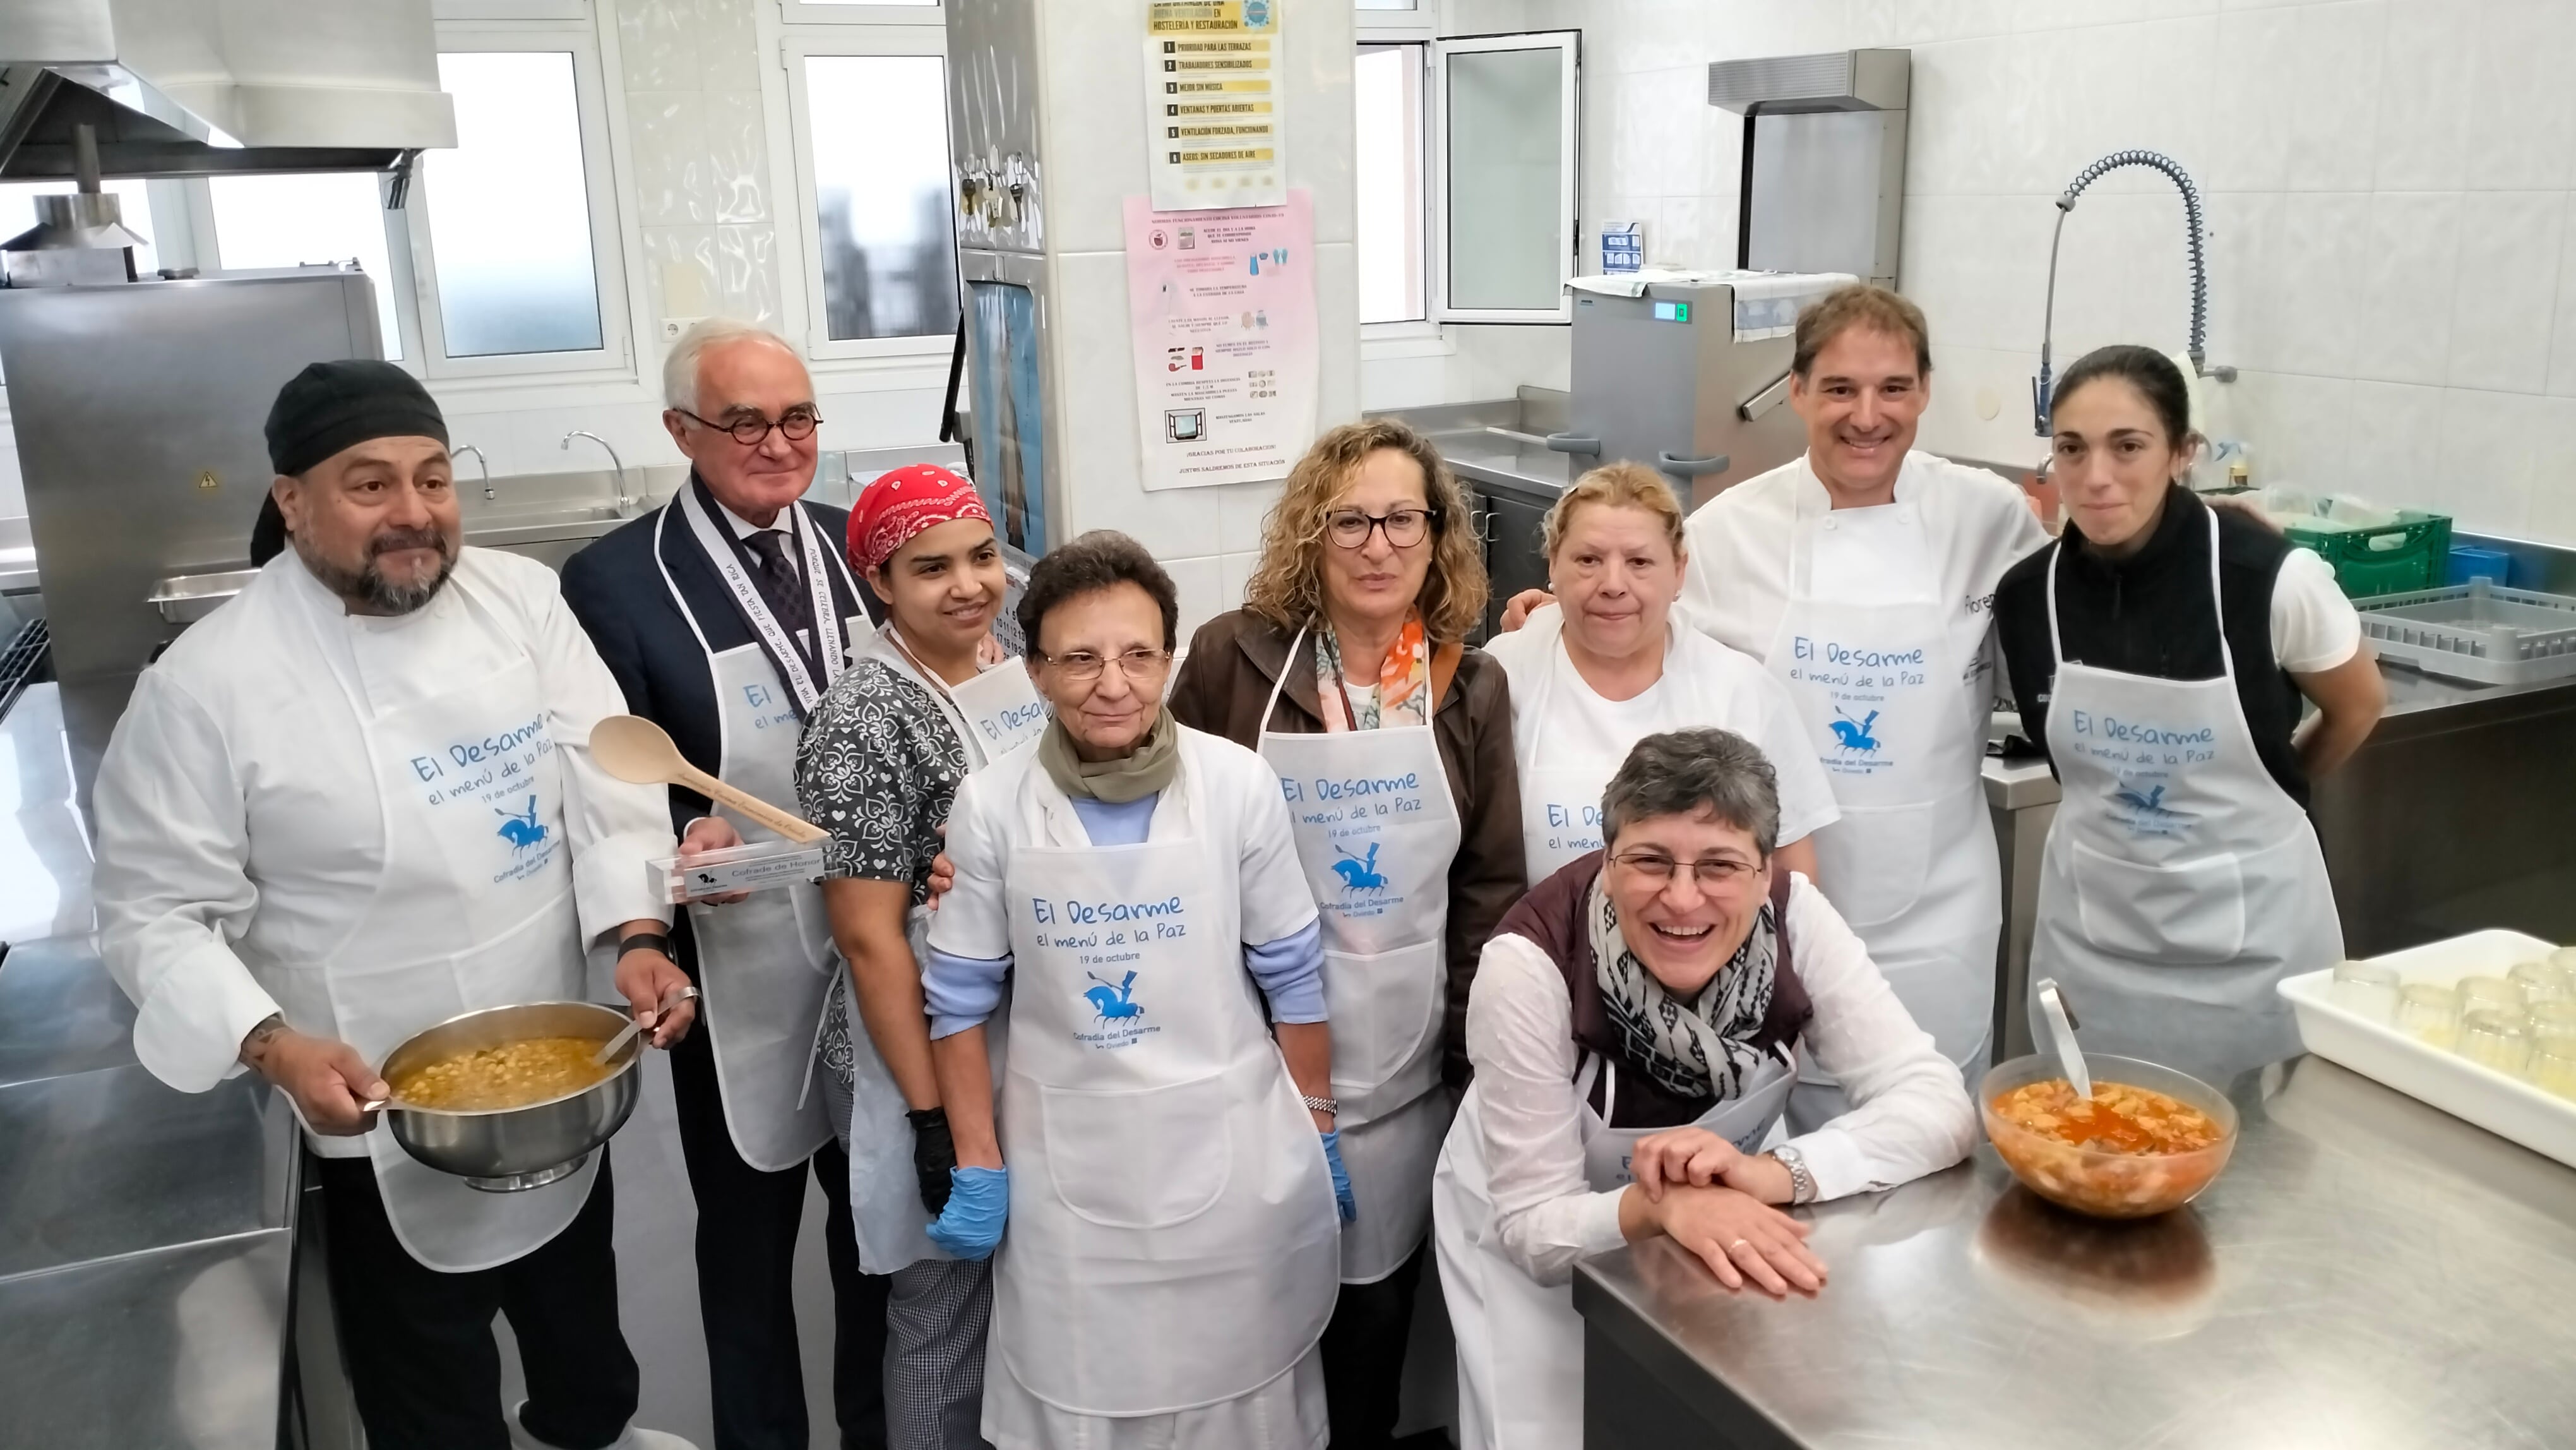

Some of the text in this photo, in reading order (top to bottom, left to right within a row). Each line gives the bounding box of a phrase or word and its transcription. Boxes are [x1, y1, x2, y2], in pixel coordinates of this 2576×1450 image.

[1214, 8, 1220, 18] EN
[1190, 21, 1194, 30] Y
[1196, 19, 1237, 30] RESTAURACIÓN
[1228, 42, 1251, 51] TERRAZAS
[1179, 60, 1252, 69] TRABAJADORES SENSIBILIZADOS
[1180, 83, 1195, 92] MEJOR
[1180, 104, 1254, 114] VENTANAS Y PUERTAS ABIERTAS
[1200, 152, 1208, 160] SIN
[1209, 151, 1237, 160] SECADORES
[1237, 150, 1243, 159] DE
[1245, 150, 1256, 158] AIRE
[725, 563, 740, 582] RICA
[736, 582, 749, 597] TAN
[746, 597, 765, 621] FIESTA
[809, 548, 821, 574] PORQUE
[816, 578, 824, 588] SE
[825, 627, 839, 666] LLENANDO
[1794, 635, 1924, 668] El Desarme
[795, 674, 805, 685] EL
[1790, 668, 1924, 688] el menú de la Paz
[743, 684, 772, 709] El
[801, 686, 813, 705] VIVA
[1841, 693, 1851, 701] de
[754, 709, 797, 729] el me
[979, 702, 1041, 741] El Desa
[2074, 709, 2215, 746] El Desarme
[410, 713, 544, 783] El Desarme
[2075, 742, 2085, 753] el
[2136, 751, 2154, 765] de
[2164, 753, 2178, 765] la
[2186, 749, 2215, 763] Paz
[428, 738, 554, 806] el menú de la Paz
[481, 775, 535, 805] 19 de octubre
[1280, 772, 1420, 803] El Desarme
[1303, 806, 1344, 825] menú
[1350, 805, 1368, 820] de
[1374, 803, 1389, 816] la
[1395, 796, 1422, 813] Paz
[1547, 804, 1603, 828] El De
[1328, 824, 1381, 839] 19 de octubre
[1548, 836, 1561, 849] el
[525, 856, 537, 868] del
[537, 838, 561, 863] Desarme
[731, 865, 772, 877] Cofrade
[774, 861, 787, 870] de
[789, 858, 821, 869] Honor
[1032, 896, 1184, 925] El Desarme
[1354, 899, 1366, 909] del
[1368, 896, 1404, 907] Desarme
[1037, 922, 1187, 949] el menú de la Paz
[1080, 951, 1141, 964] 19 de octubre
[1107, 1030, 1120, 1040] del
[1122, 1025, 1161, 1038] Desarme
